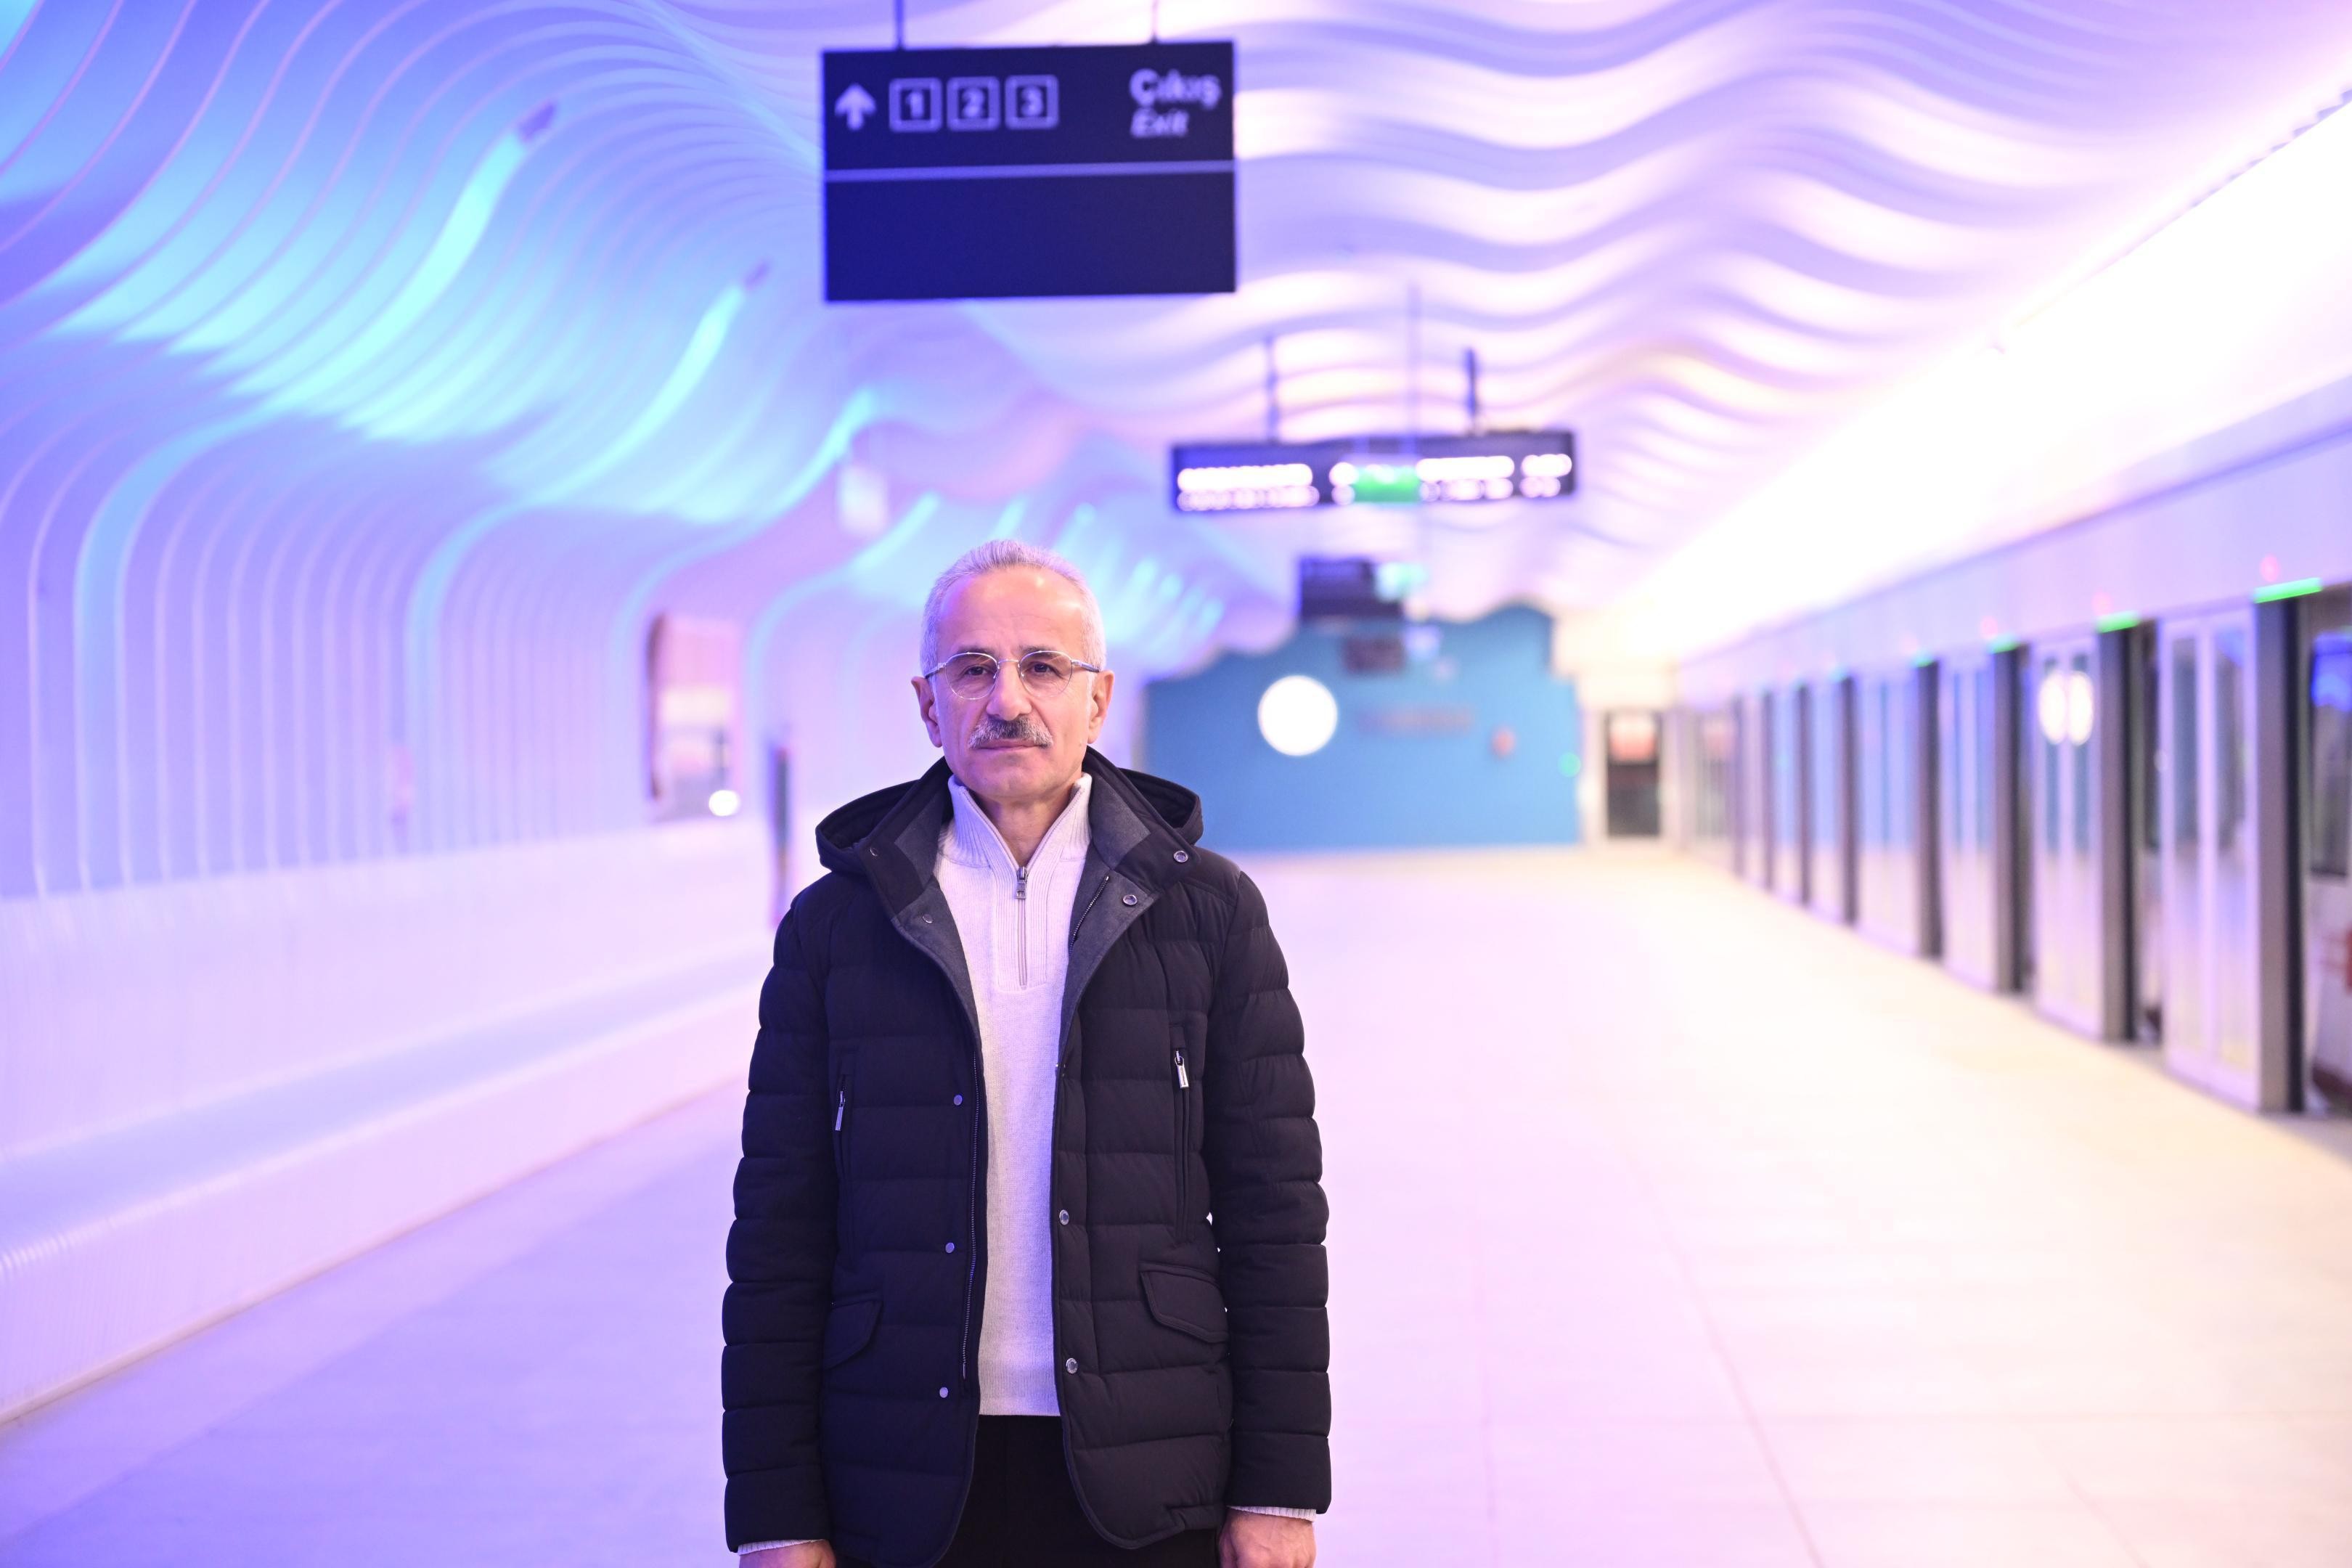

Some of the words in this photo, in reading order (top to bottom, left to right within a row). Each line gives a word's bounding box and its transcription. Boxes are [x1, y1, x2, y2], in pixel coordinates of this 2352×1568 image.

[906, 91, 925, 118] 1
[962, 88, 984, 118] 2
[1021, 86, 1044, 117] 3
